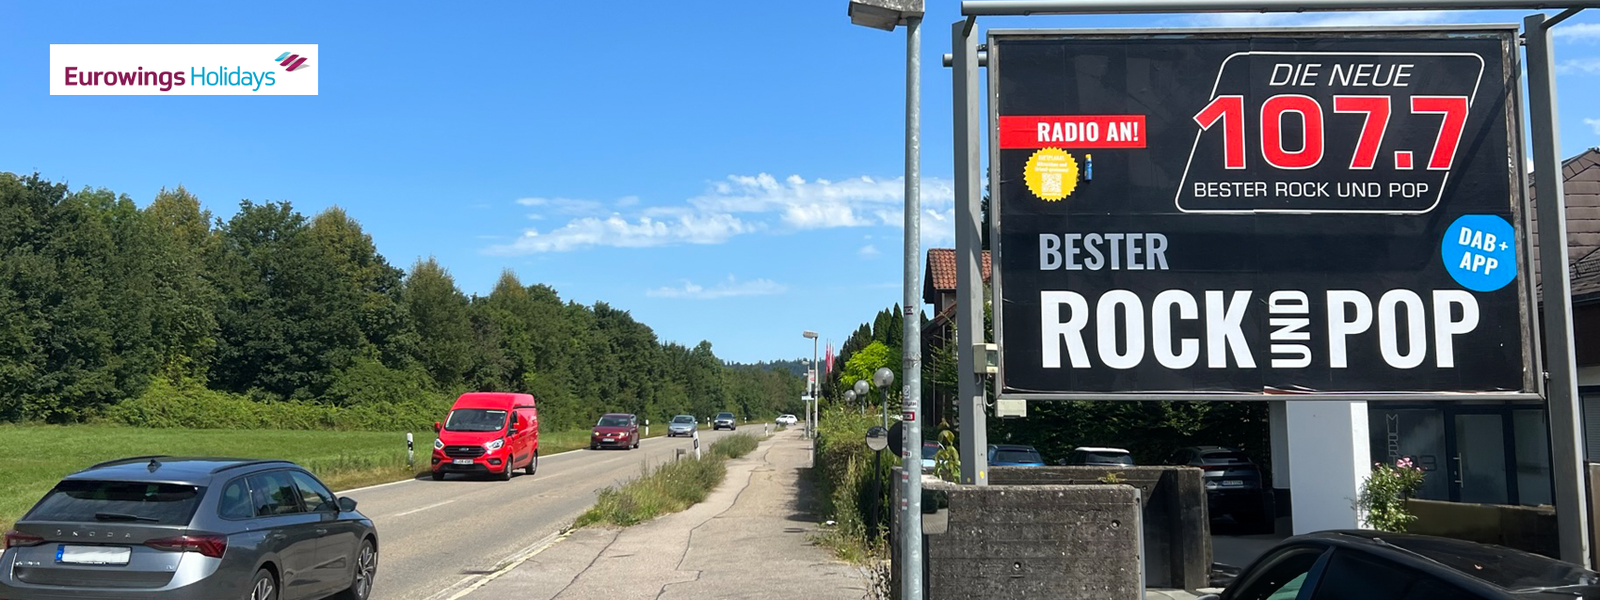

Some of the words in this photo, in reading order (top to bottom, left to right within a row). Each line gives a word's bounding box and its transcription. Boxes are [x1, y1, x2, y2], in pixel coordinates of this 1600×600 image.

[1268, 64, 1322, 87] DIE
[1328, 63, 1415, 87] NEUE
[1037, 122, 1099, 142] RADIO
[1107, 122, 1139, 141] AN!
[1193, 94, 1470, 170] 107.7
[1194, 182, 1268, 198] BESTER
[1275, 182, 1330, 198] ROCK
[1337, 182, 1382, 198] UND
[1388, 182, 1429, 198] POP
[1039, 233, 1170, 271] BESTER
[1458, 254, 1499, 277] APP
[1041, 289, 1257, 370] ROCK
[1268, 290, 1312, 369] UND
[1327, 289, 1480, 370] POP
